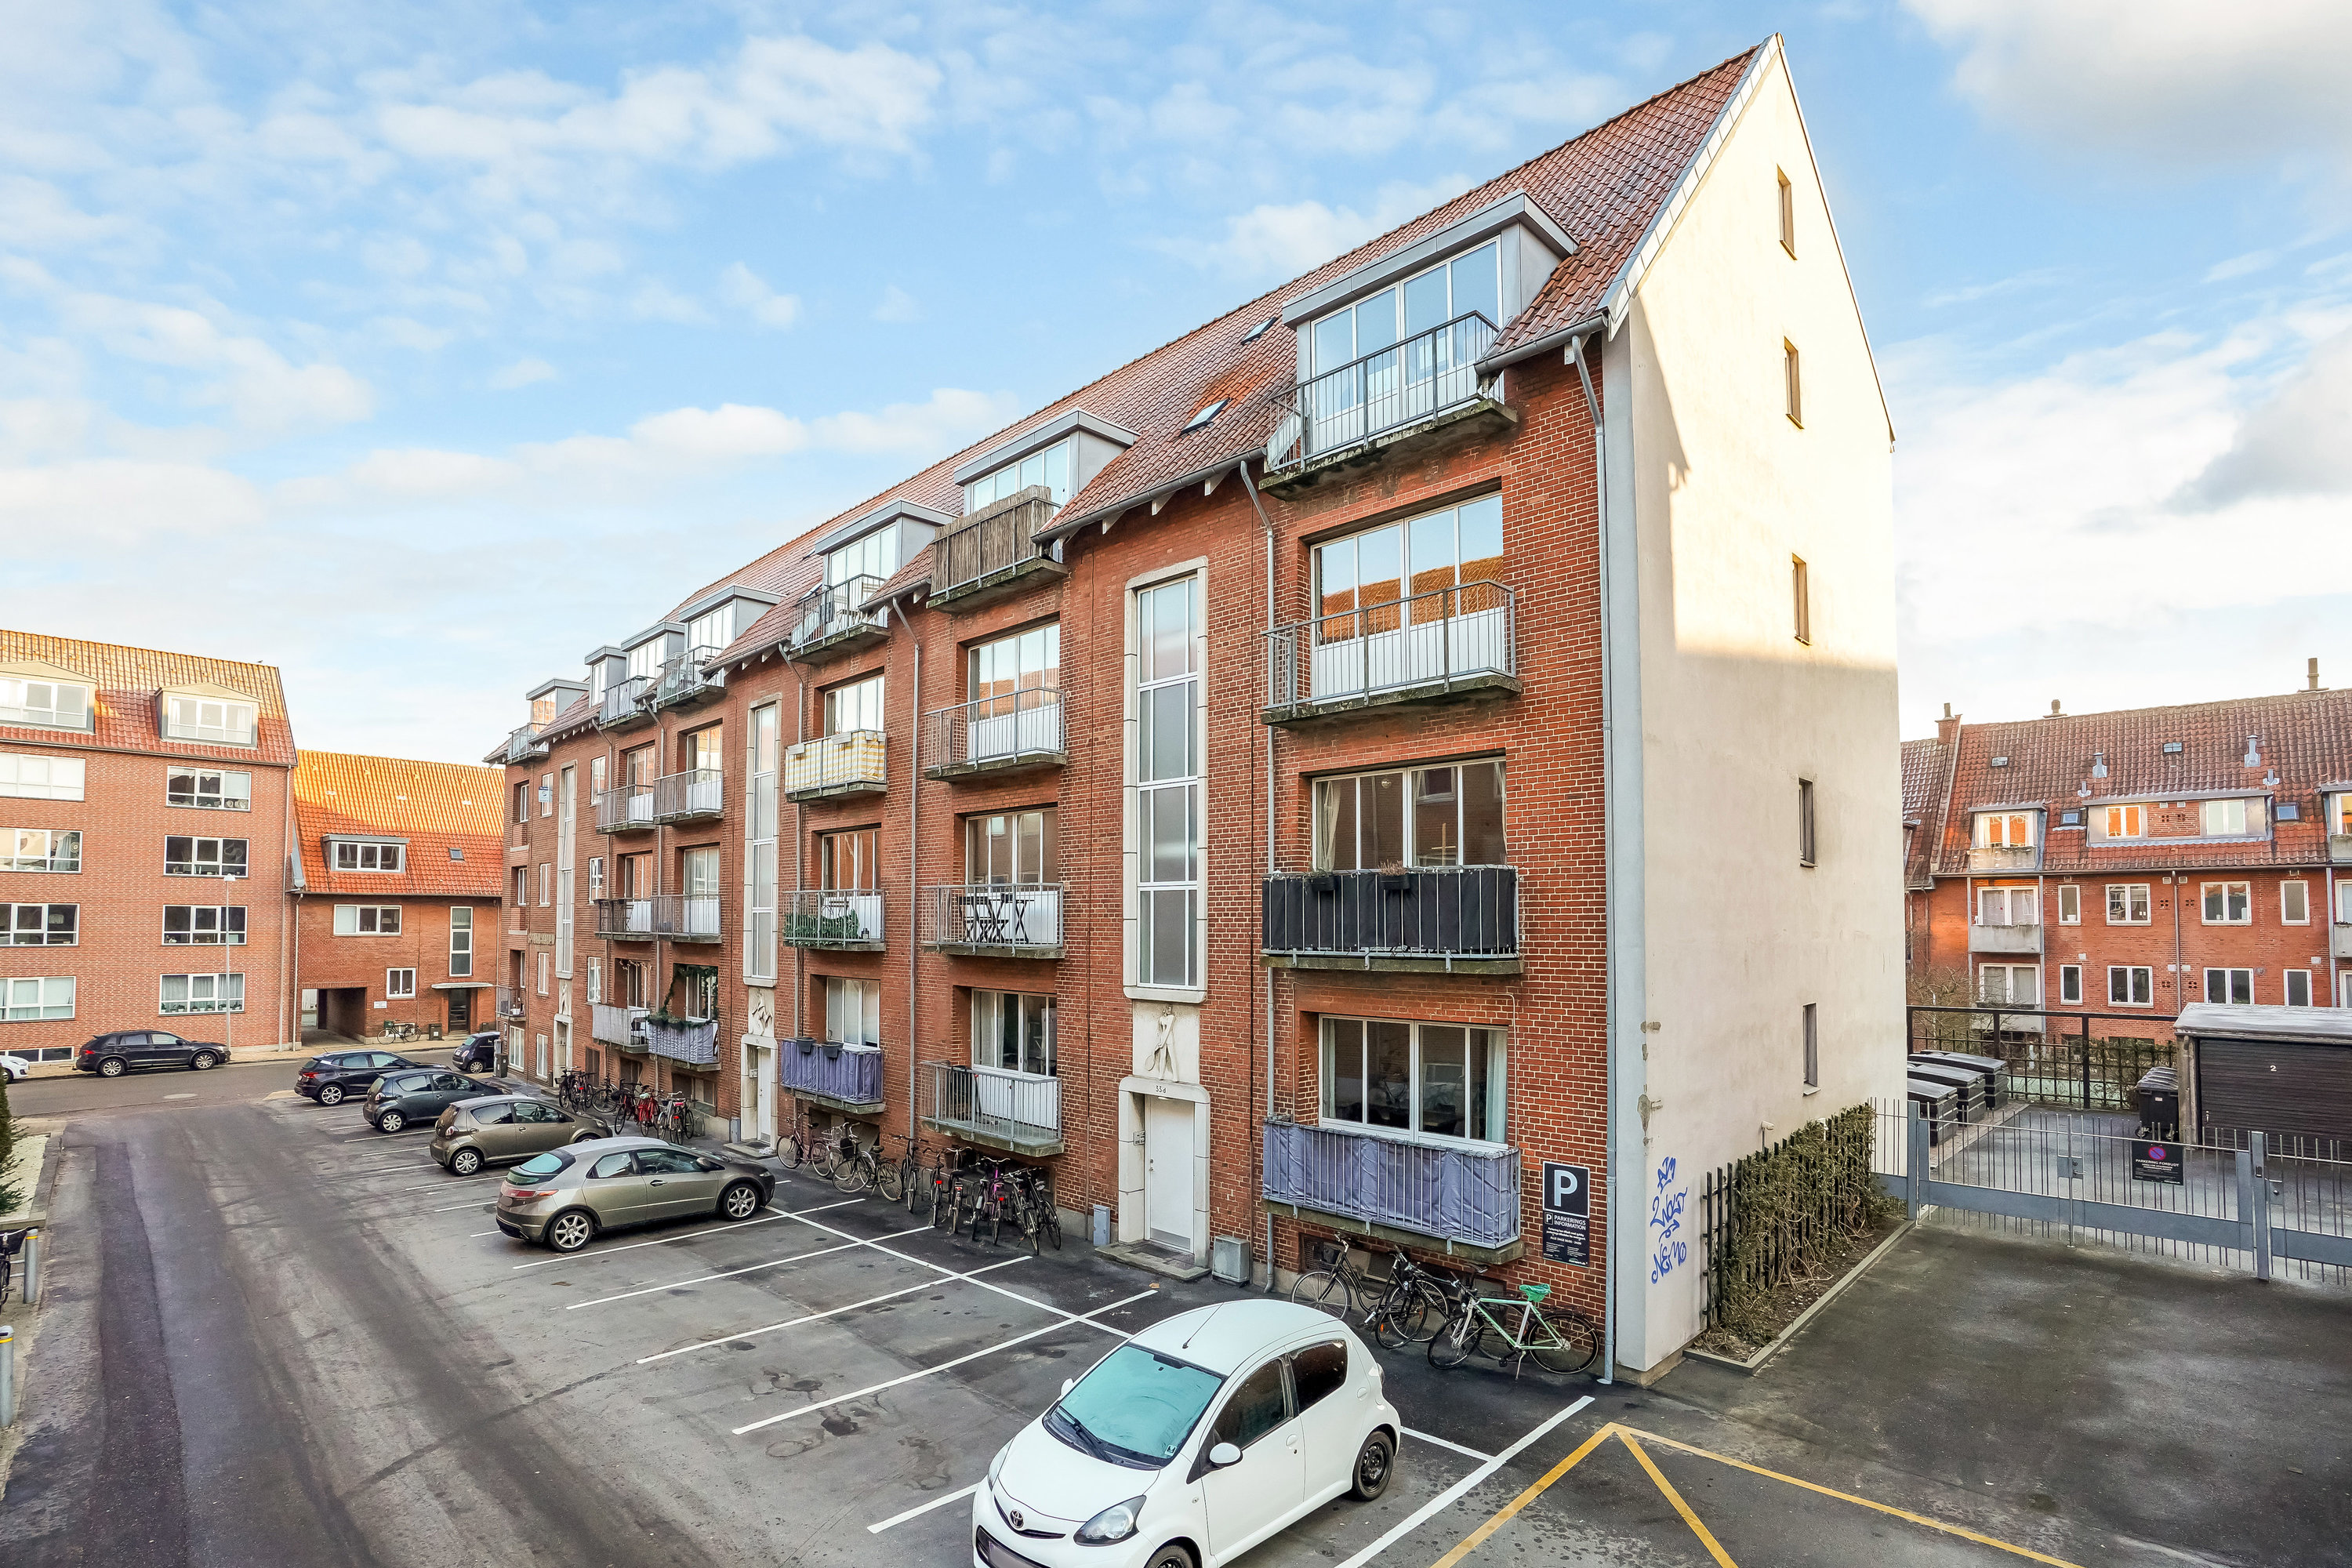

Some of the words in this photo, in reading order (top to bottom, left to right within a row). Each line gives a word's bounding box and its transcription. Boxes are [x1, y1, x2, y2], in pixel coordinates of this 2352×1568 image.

[1555, 1170, 1577, 1207] P
[1546, 1214, 1552, 1223] P
[1554, 1215, 1586, 1225] PARKERINGS
[1554, 1220, 1586, 1230] INFORMATION
